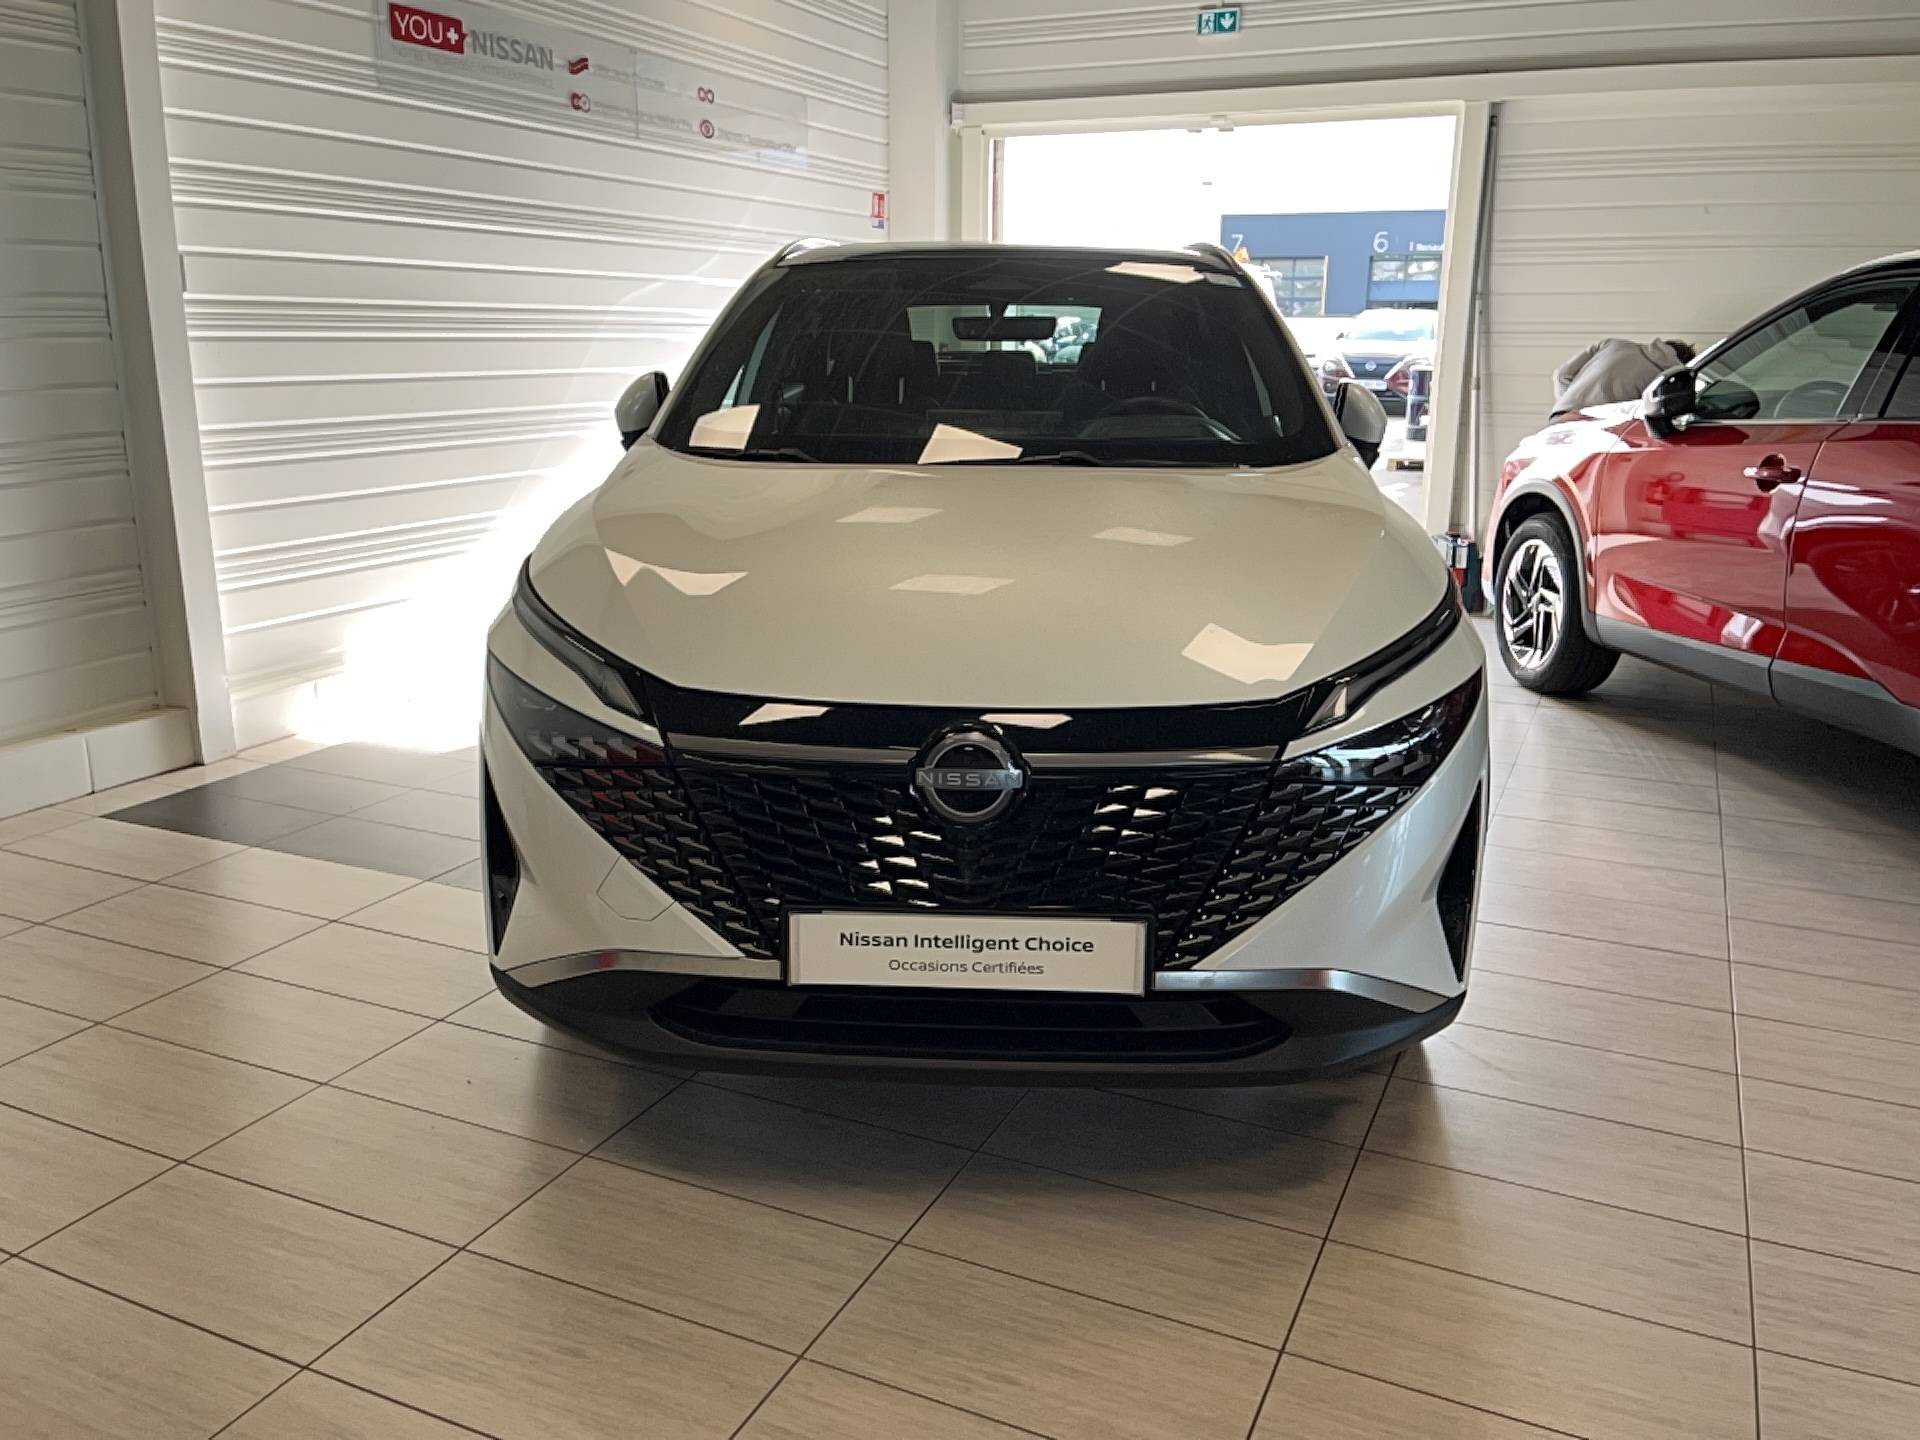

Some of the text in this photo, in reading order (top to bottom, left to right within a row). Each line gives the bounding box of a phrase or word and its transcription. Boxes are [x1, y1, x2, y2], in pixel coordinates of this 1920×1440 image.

[470, 29, 554, 71] NISSAN
[1231, 234, 1244, 252] 7
[1372, 231, 1389, 252] 6
[917, 770, 1022, 788] NISSAN
[839, 932, 1095, 954] Nissan Intelligent Choice
[888, 959, 1045, 975] Occasions Certifiées
